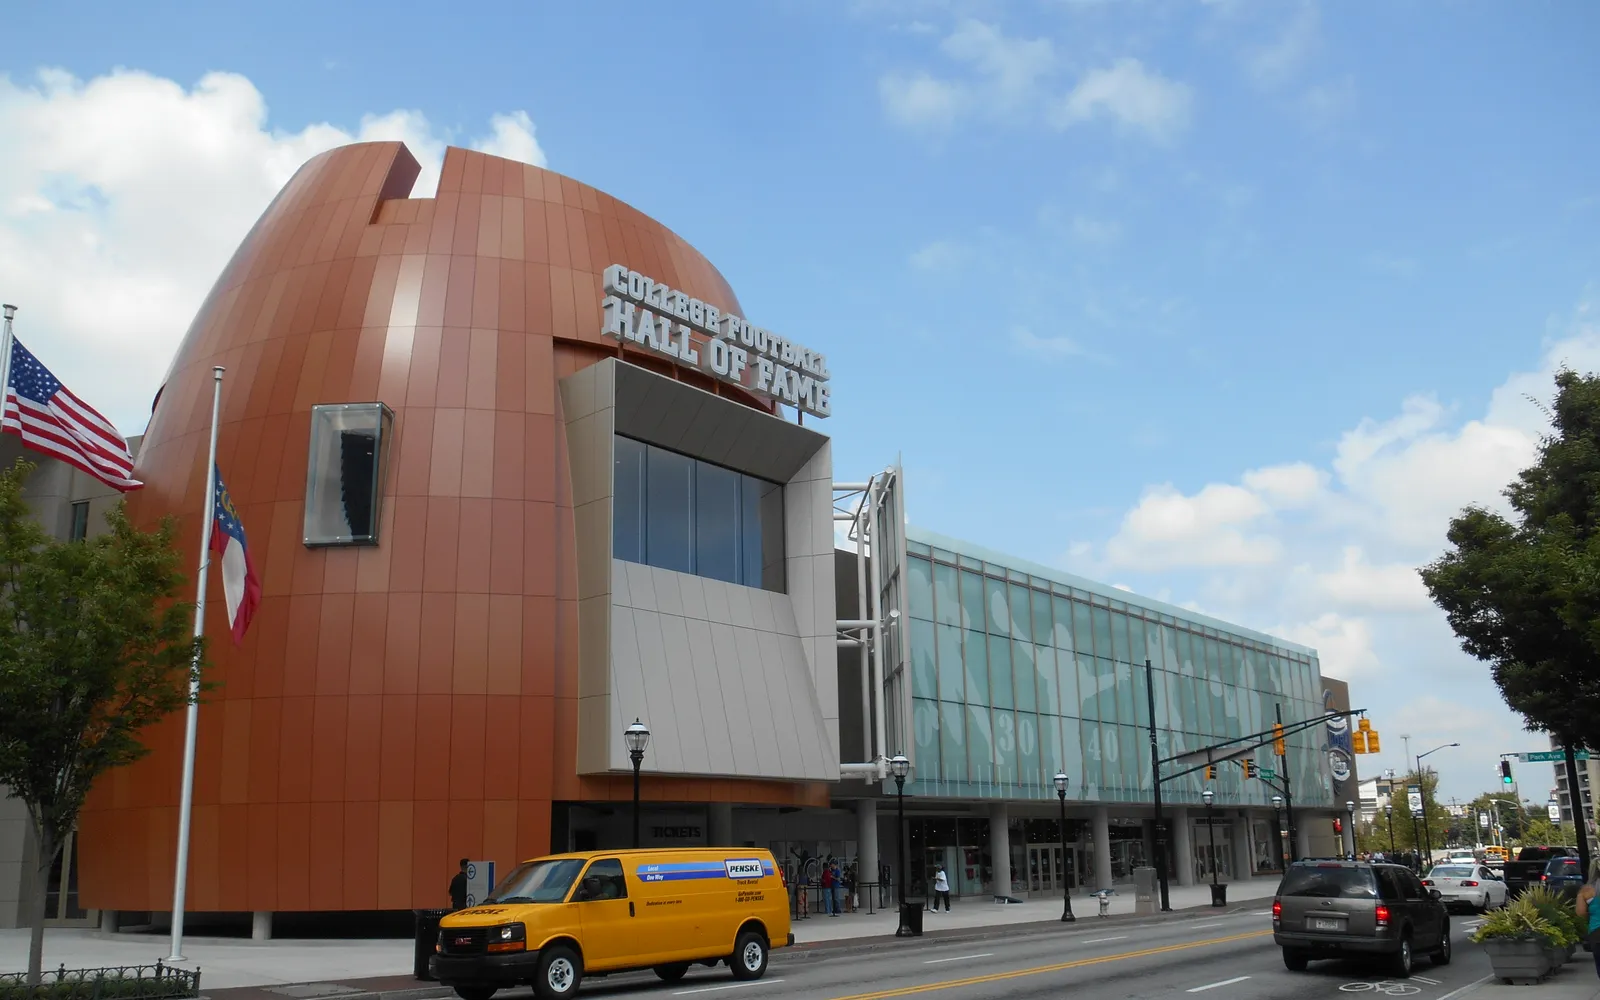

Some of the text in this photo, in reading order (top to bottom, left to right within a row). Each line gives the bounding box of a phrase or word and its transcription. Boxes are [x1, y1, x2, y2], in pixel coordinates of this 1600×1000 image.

[603, 264, 830, 380] COLLEGE FOOTBALL
[602, 295, 831, 417] HALL OF FAME
[998, 713, 1034, 756] 30
[1088, 727, 1119, 763] 40
[652, 826, 701, 838] TICKETS
[729, 864, 760, 873] PENSKE
